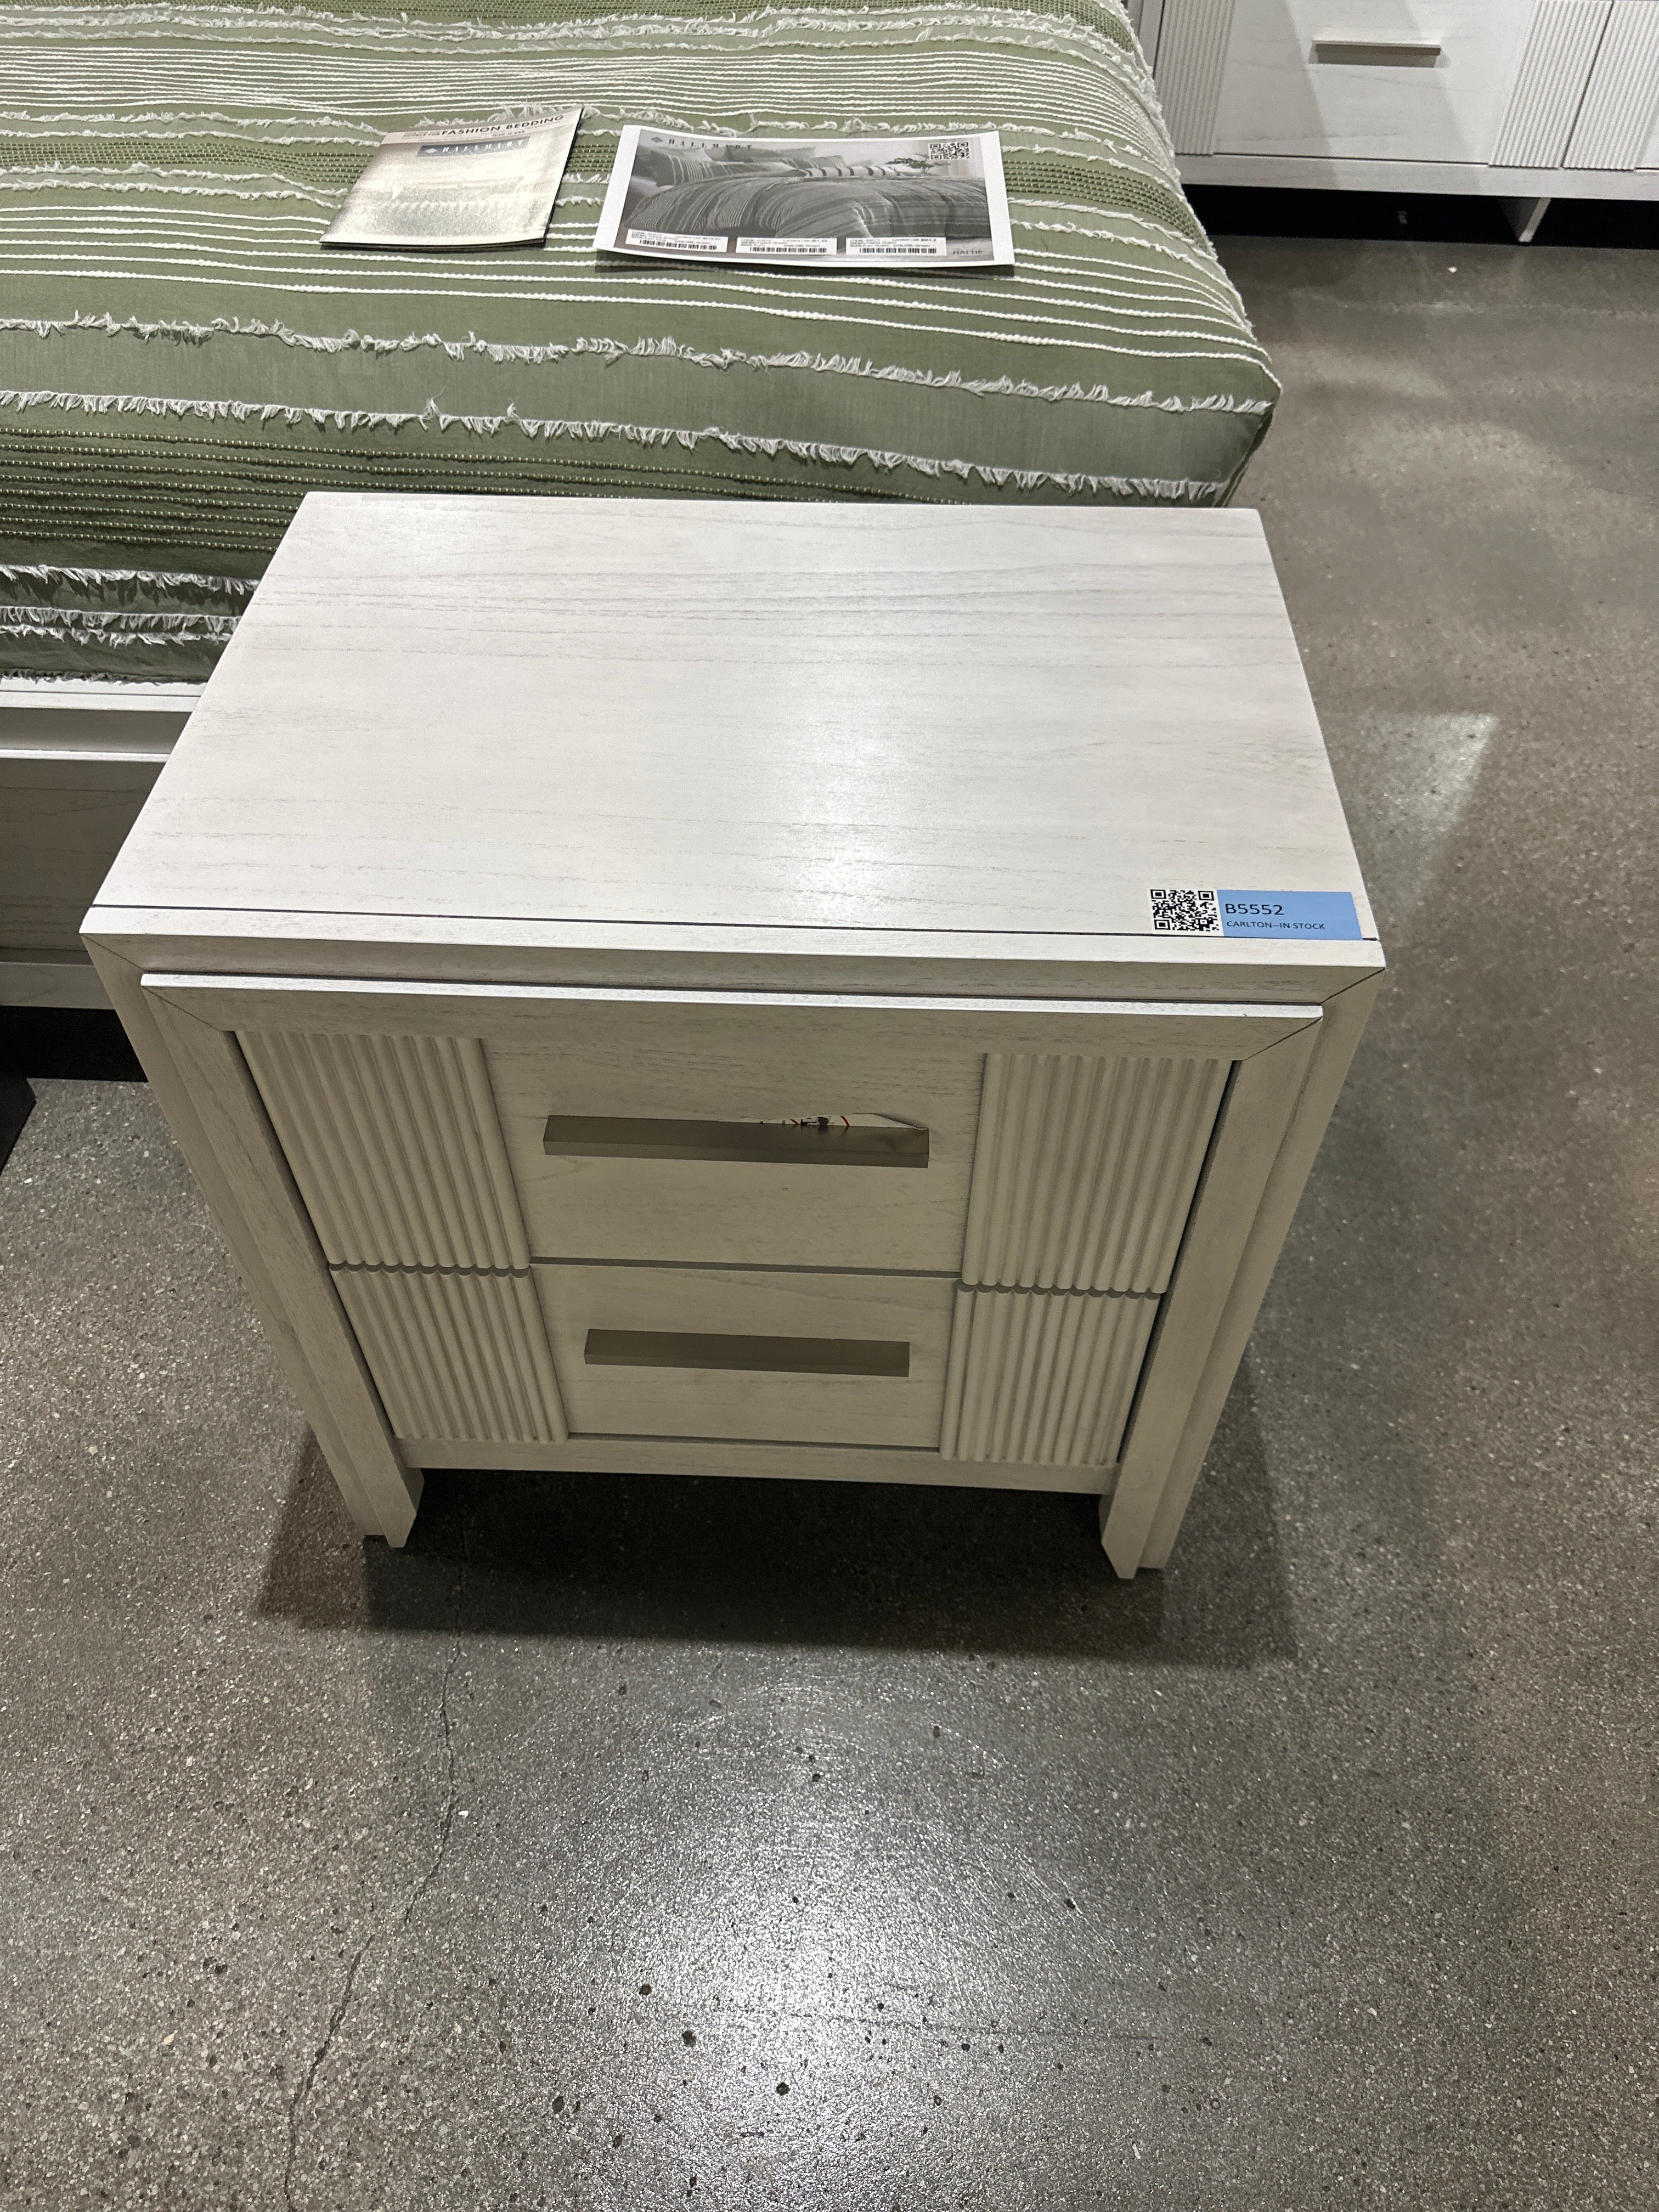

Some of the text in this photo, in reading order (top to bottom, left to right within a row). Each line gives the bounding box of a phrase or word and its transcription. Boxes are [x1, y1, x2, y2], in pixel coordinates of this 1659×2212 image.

[442, 126, 500, 135] FASHION
[506, 115, 563, 129] BEDDING
[1225, 904, 1284, 915] B5552
